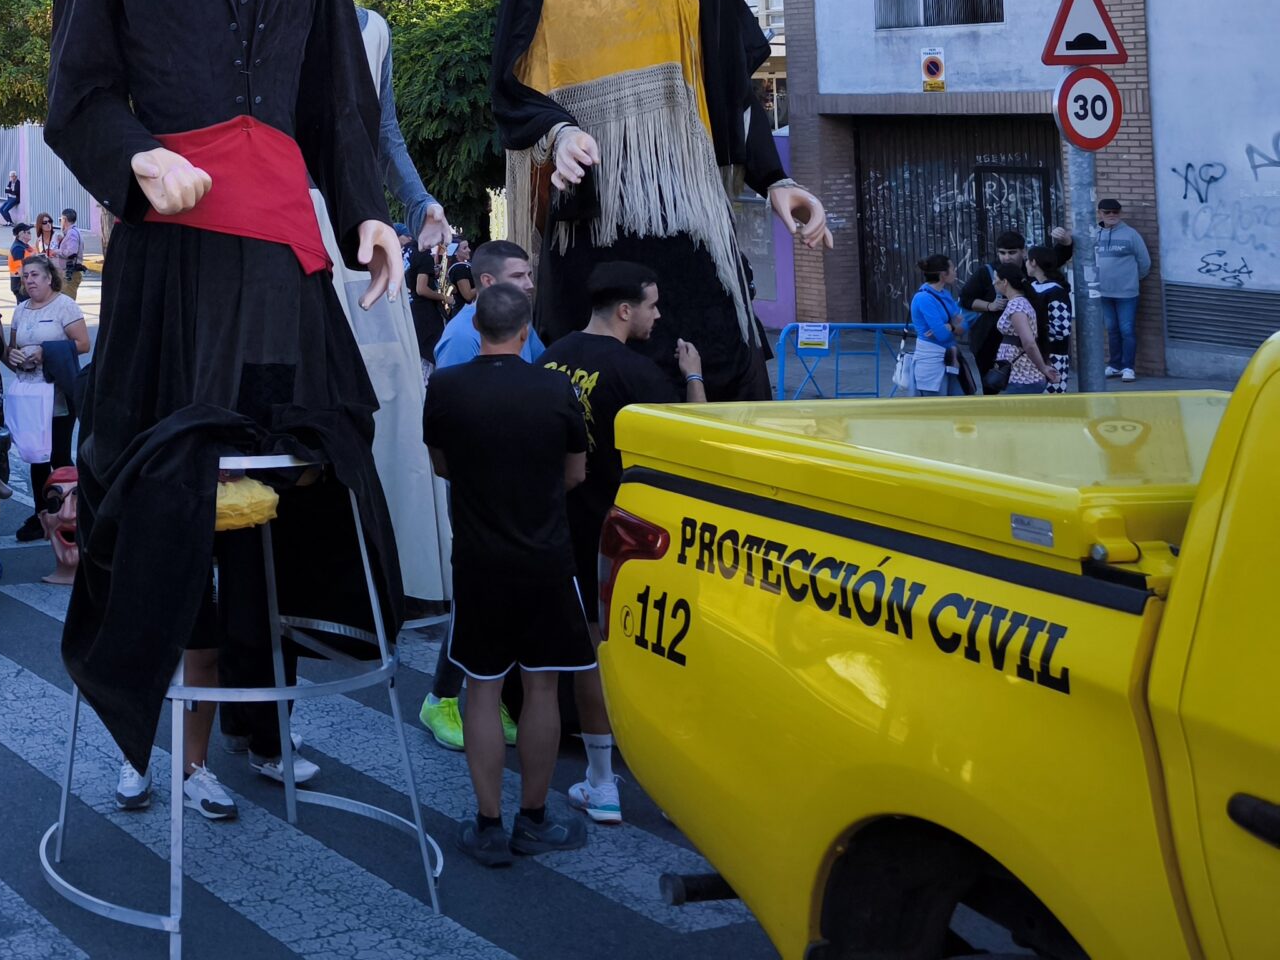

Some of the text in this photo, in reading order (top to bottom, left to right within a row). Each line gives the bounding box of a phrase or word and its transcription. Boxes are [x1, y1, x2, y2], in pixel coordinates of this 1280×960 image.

[1073, 94, 1107, 121] 30
[634, 584, 691, 667] 112
[677, 517, 1071, 695] PROTECCIÓN CIVIL
